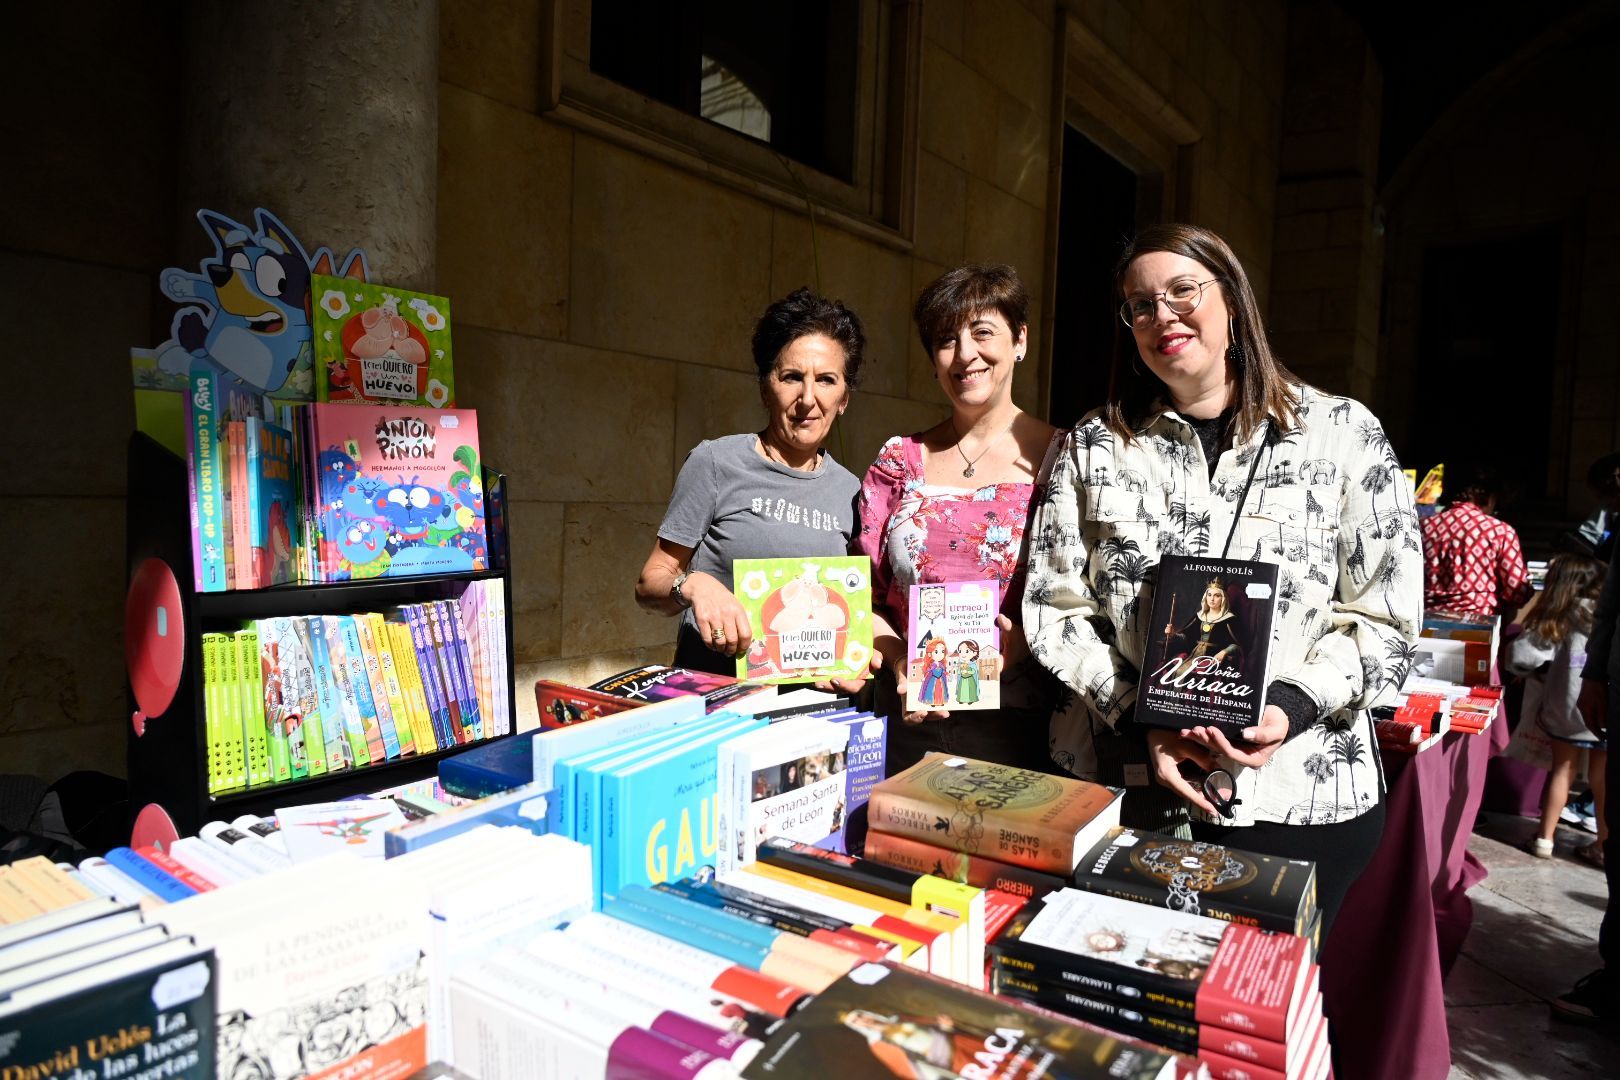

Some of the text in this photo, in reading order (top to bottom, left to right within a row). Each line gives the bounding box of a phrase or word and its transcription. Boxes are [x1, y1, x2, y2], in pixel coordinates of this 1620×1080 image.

[383, 360, 413, 374] QUIERO
[376, 416, 436, 439] ANTÓN
[194, 377, 214, 538] BLUEY EL GRAN LIBRO POP-UP
[1184, 564, 1252, 576] ALFONSO SOLÍS
[801, 630, 832, 642] QUIERO
[1151, 656, 1254, 697] Urraca
[1192, 656, 1242, 679] Doña
[604, 674, 637, 691] CHLOE
[621, 668, 693, 700] Keeping
[1148, 686, 1197, 701] EMPERATRIZ
[1200, 695, 1210, 704] DE
[1214, 696, 1252, 710] HISPANIA
[848, 744, 872, 754] oficios
[854, 750, 882, 764] León
[848, 762, 882, 773] sorprendente
[944, 772, 995, 802] ALAS
[976, 770, 1046, 810] SANGRE
[764, 782, 838, 820] Semana Santa
[782, 806, 824, 831] de León
[888, 814, 932, 832] REBECCA
[891, 806, 928, 822] YARROS
[1000, 828, 1040, 848] SANGRE
[888, 851, 924, 868] YARROS
[1000, 840, 1038, 859] ALAS DE
[996, 878, 1033, 896] HIERRO
[264, 938, 288, 957] LA
[234, 964, 256, 983] DE
[264, 956, 296, 975] LAS
[302, 936, 354, 961] CASAS
[1062, 970, 1113, 992] LLAMAZARES
[1065, 992, 1116, 1014] LLAMAZARES
[156, 1012, 188, 1036] La
[103, 1053, 140, 1080] las
[144, 1028, 200, 1064] luces
